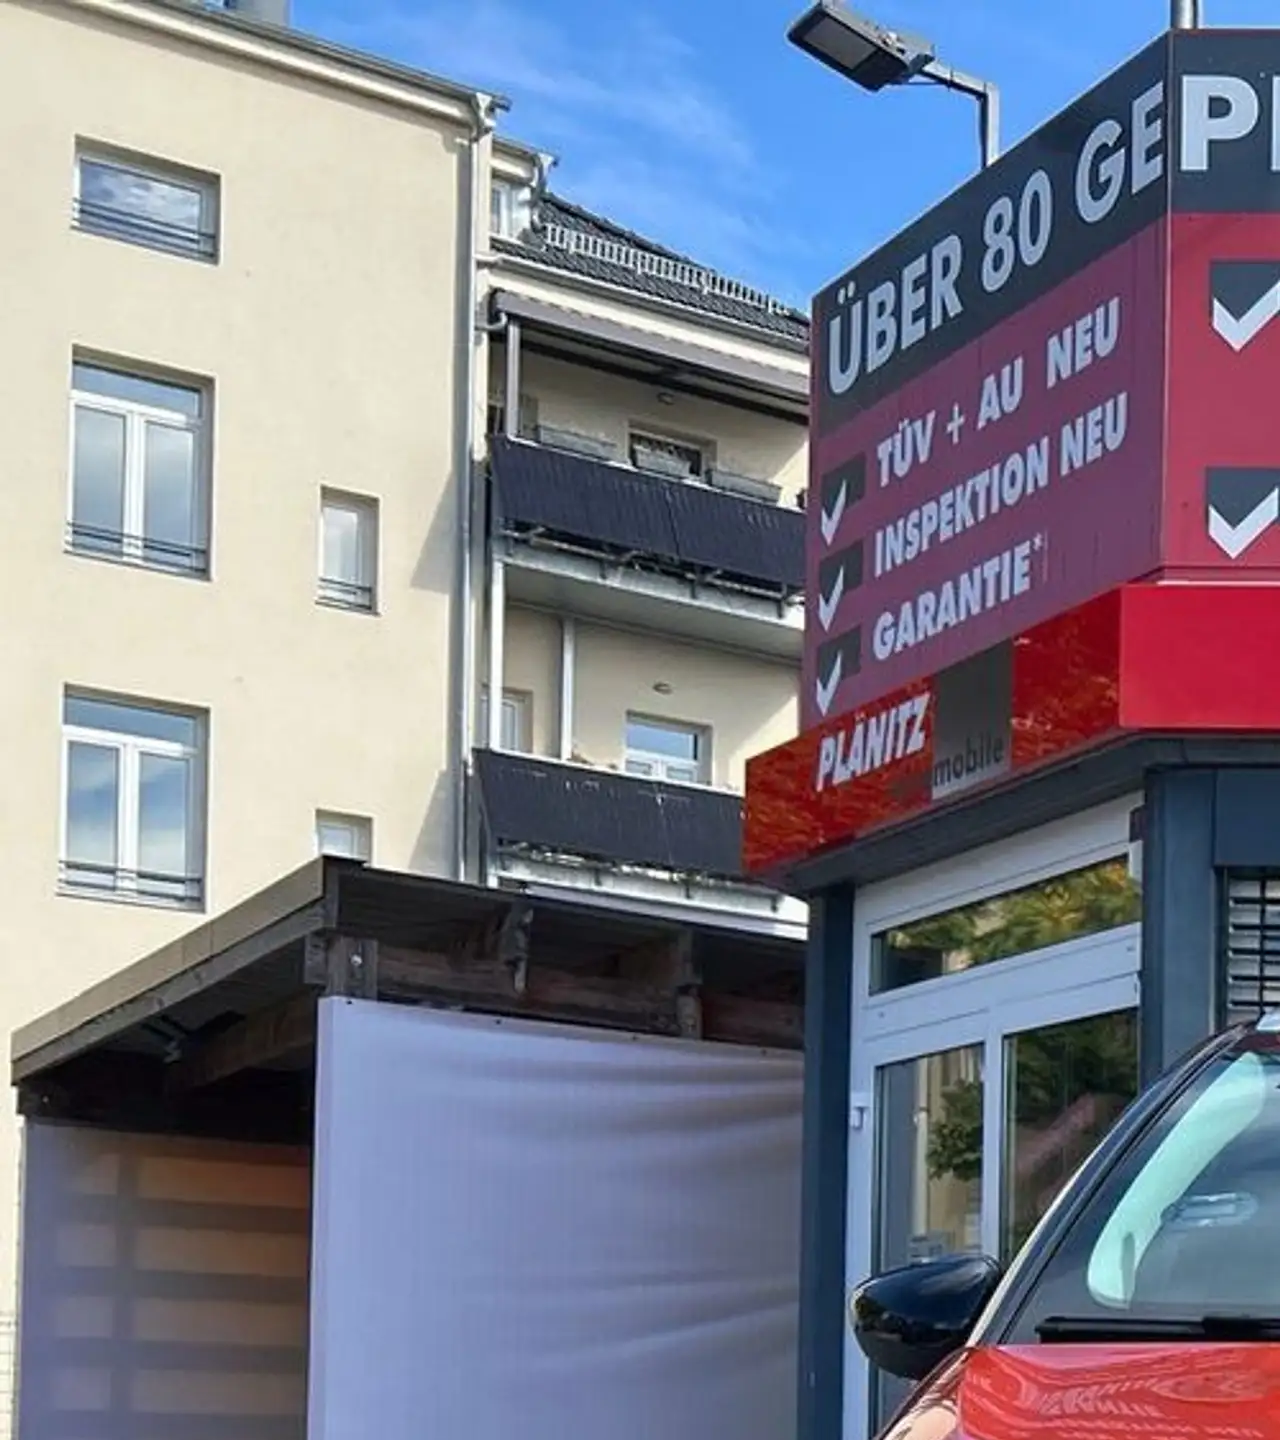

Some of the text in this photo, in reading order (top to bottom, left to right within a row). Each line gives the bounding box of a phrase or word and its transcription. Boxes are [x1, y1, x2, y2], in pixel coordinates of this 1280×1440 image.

[828, 234, 963, 394] ÜBER
[981, 169, 1053, 293] 80
[873, 393, 1128, 578] INSPEKTION NEU
[877, 298, 1119, 488] TÜV + AU NEU
[816, 692, 931, 792] PLÄNITZ
